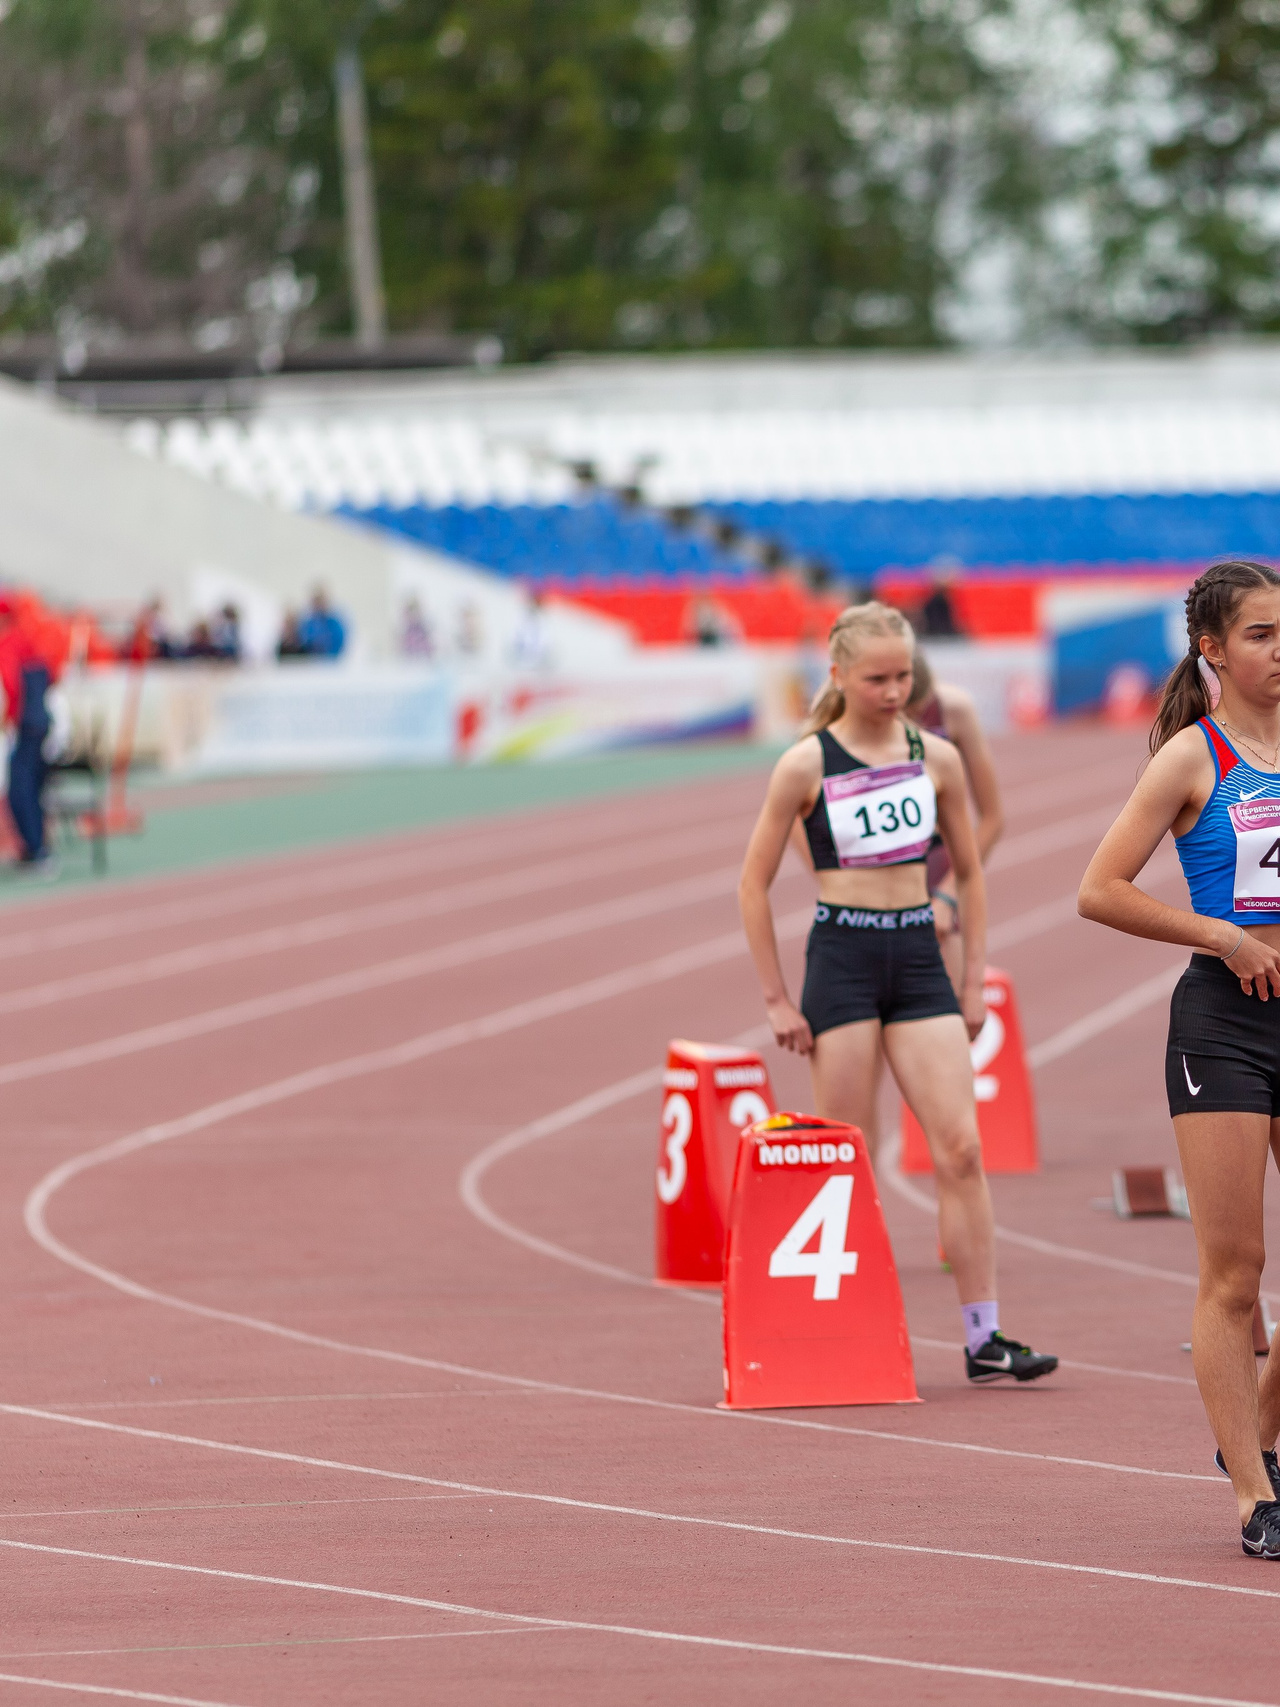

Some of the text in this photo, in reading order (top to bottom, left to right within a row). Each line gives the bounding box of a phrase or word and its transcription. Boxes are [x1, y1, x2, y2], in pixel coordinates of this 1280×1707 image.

[854, 797, 922, 838] 130
[836, 909, 898, 929] NIKE
[657, 1092, 693, 1205] 3
[759, 1142, 857, 1166] MONDO
[768, 1174, 859, 1301] 4
